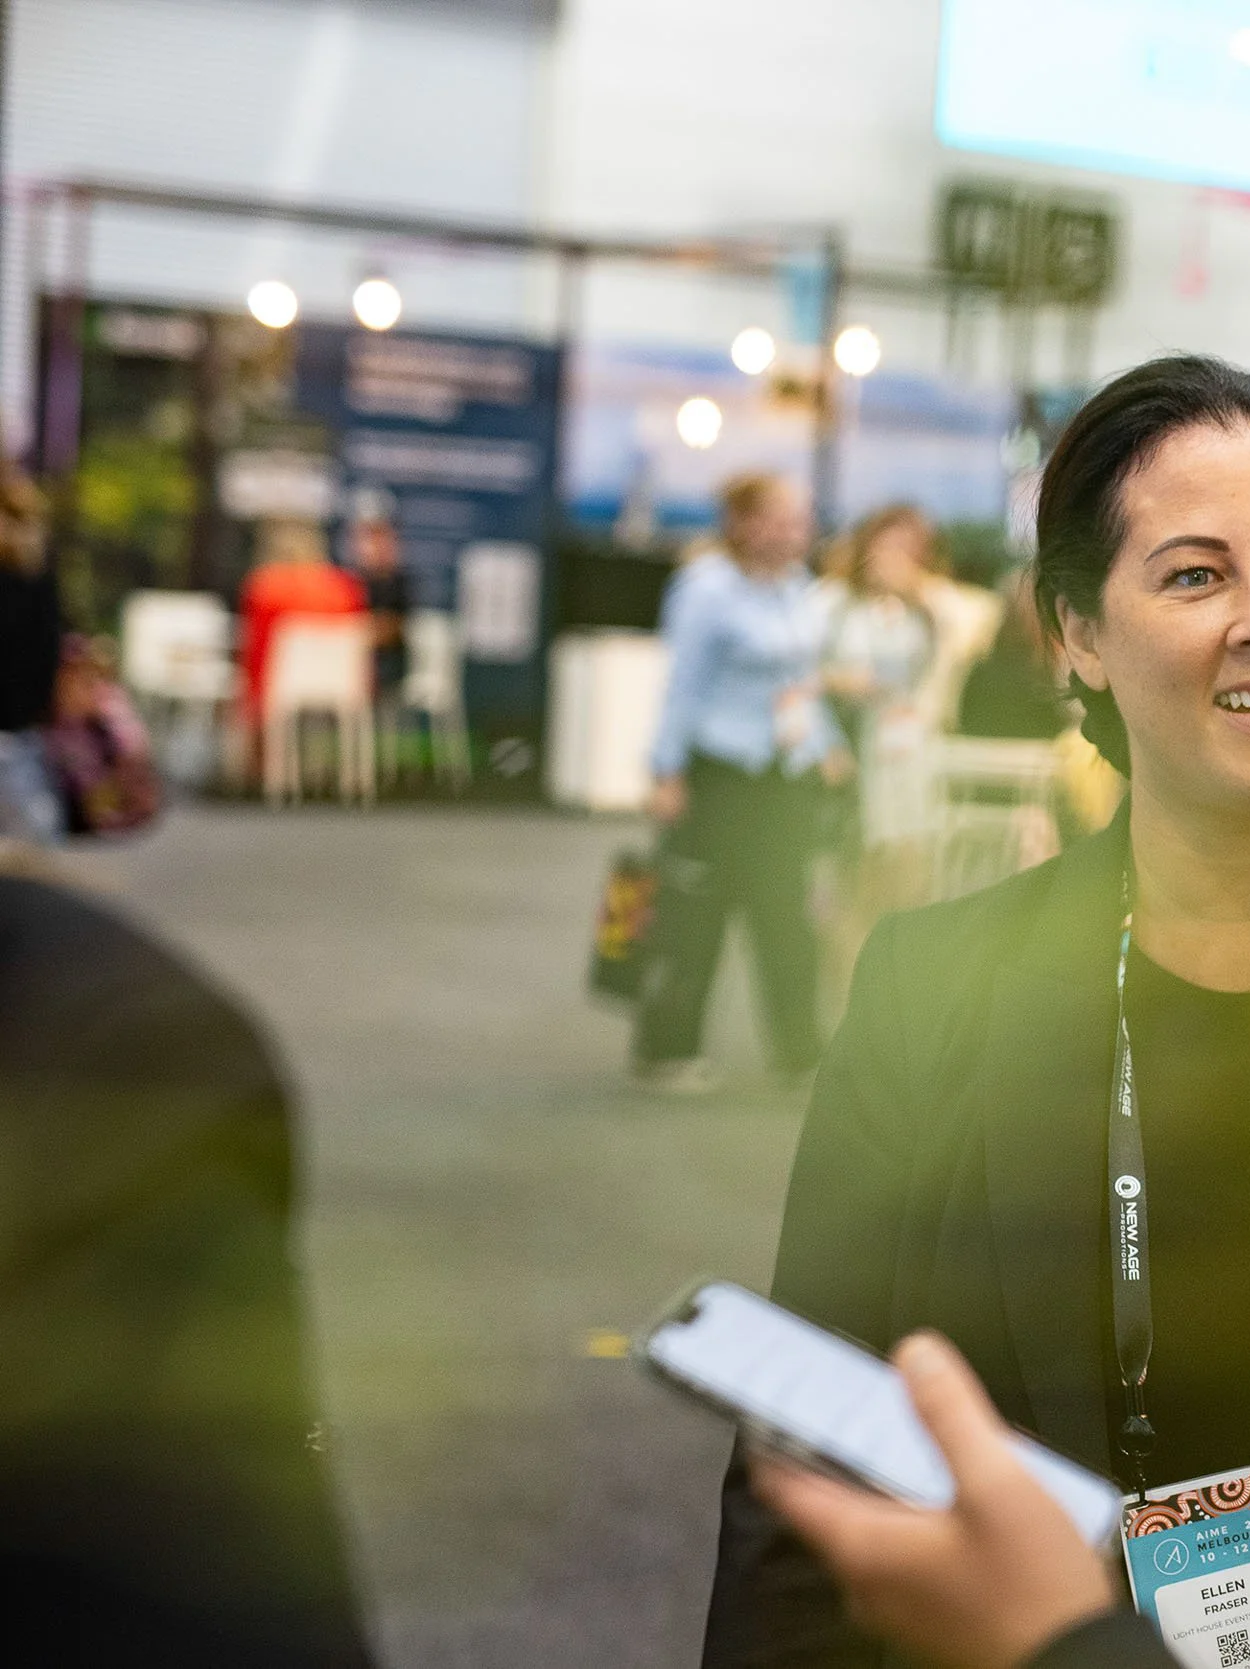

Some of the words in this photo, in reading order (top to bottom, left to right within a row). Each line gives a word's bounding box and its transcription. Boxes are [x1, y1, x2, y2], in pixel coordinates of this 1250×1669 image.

[1126, 1202, 1139, 1241] NEW
[1127, 1244, 1140, 1281] AGE
[1196, 1525, 1228, 1541] AIME
[1200, 1551, 1216, 1564] 10
[1234, 1542, 1249, 1555] 12
[1201, 1579, 1246, 1600] ELLEN
[1204, 1596, 1249, 1616] FRASER
[1172, 1628, 1195, 1641] LIGHT
[1196, 1621, 1223, 1634] HOUSE
